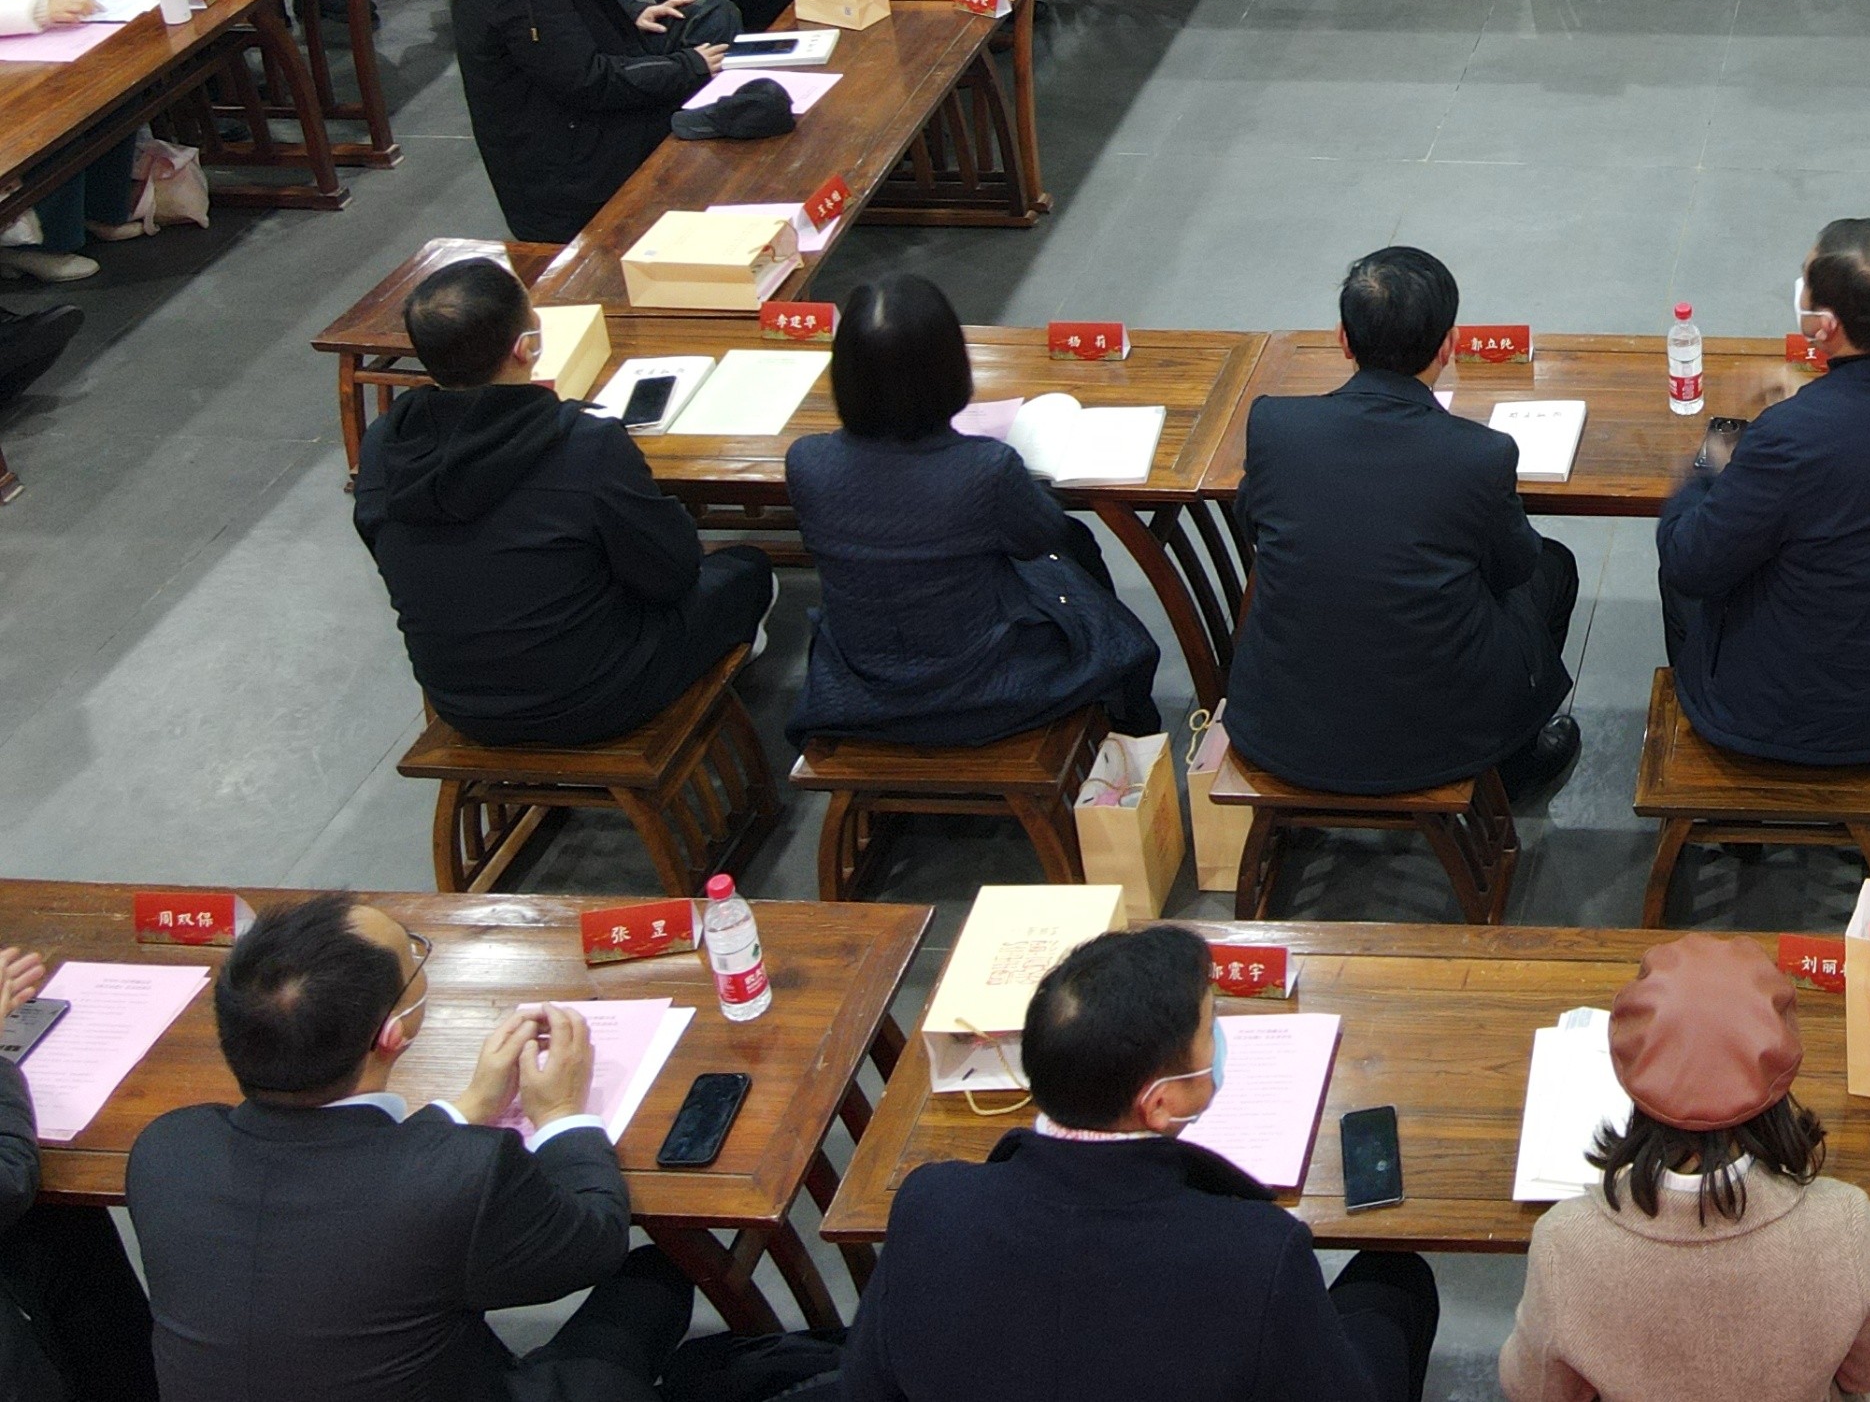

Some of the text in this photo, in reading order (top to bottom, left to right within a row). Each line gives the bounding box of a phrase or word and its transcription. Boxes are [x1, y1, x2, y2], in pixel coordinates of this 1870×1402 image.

[158, 910, 214, 929] 周双保
[1801, 954, 1847, 977] 刘丽
